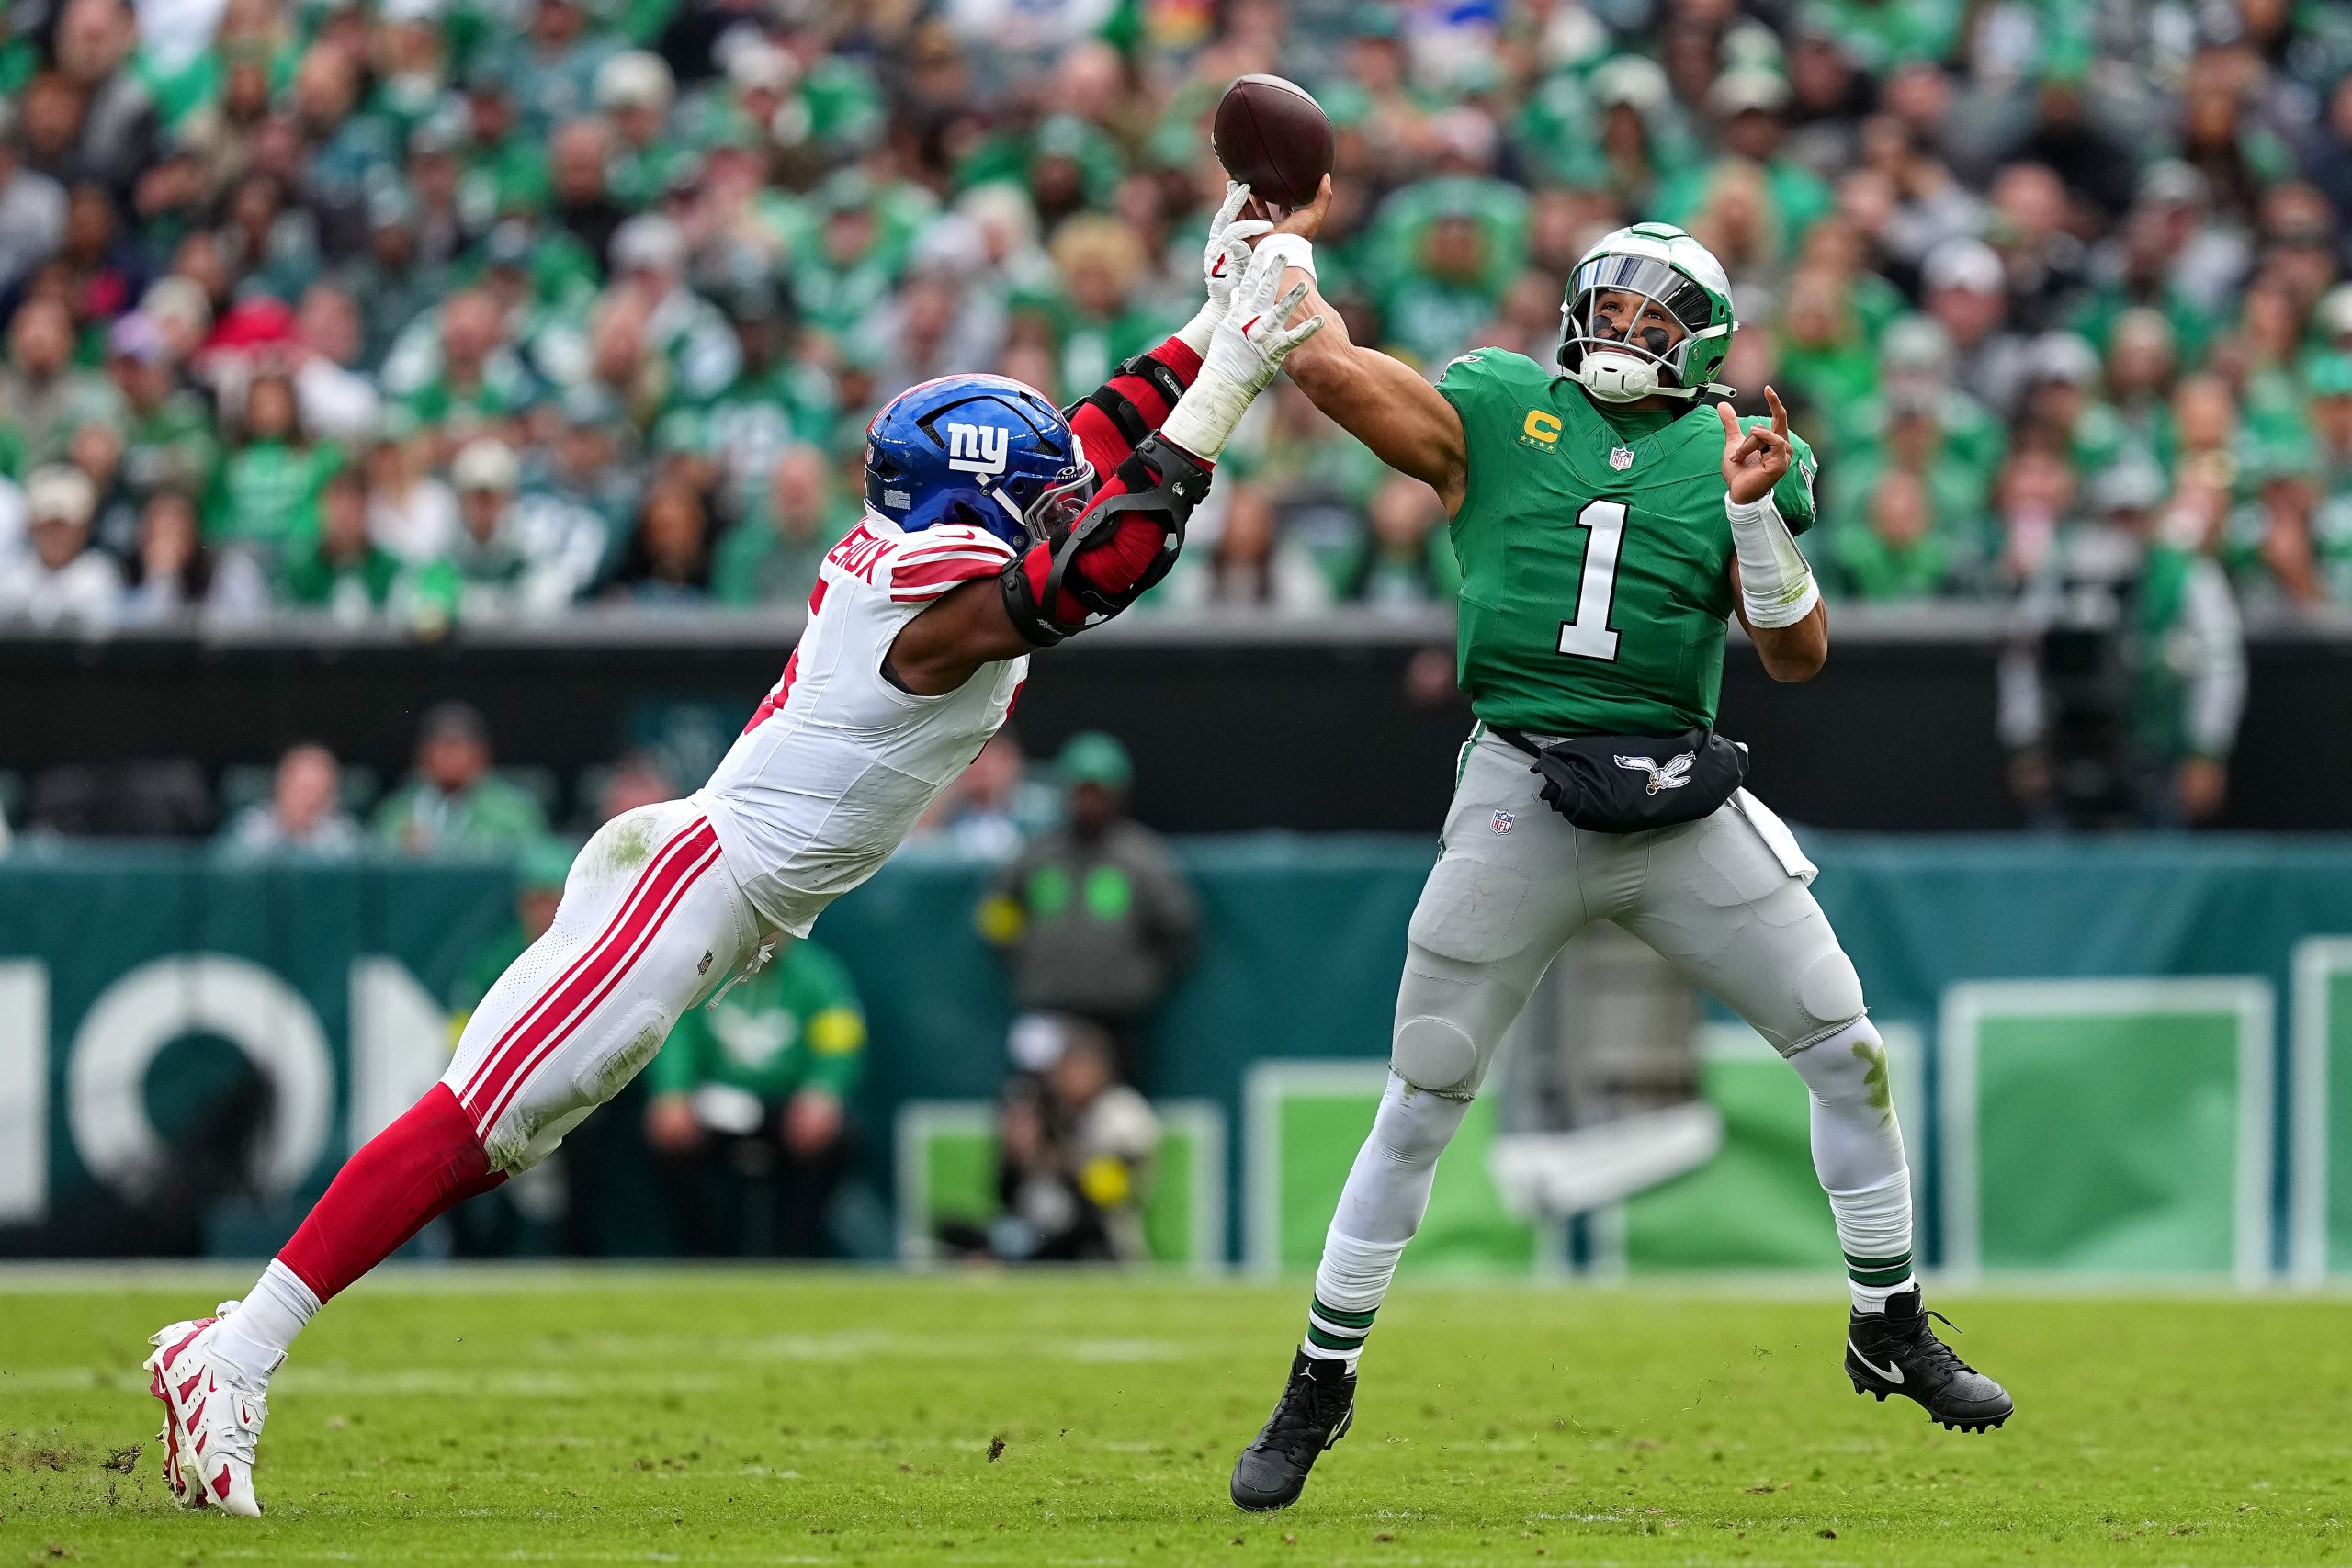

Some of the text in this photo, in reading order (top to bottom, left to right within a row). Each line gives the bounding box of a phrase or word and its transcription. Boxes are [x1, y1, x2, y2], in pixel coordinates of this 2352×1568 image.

[1522, 409, 1563, 444] C
[828, 517, 899, 586] EAUX
[1555, 498, 1630, 664] 1
